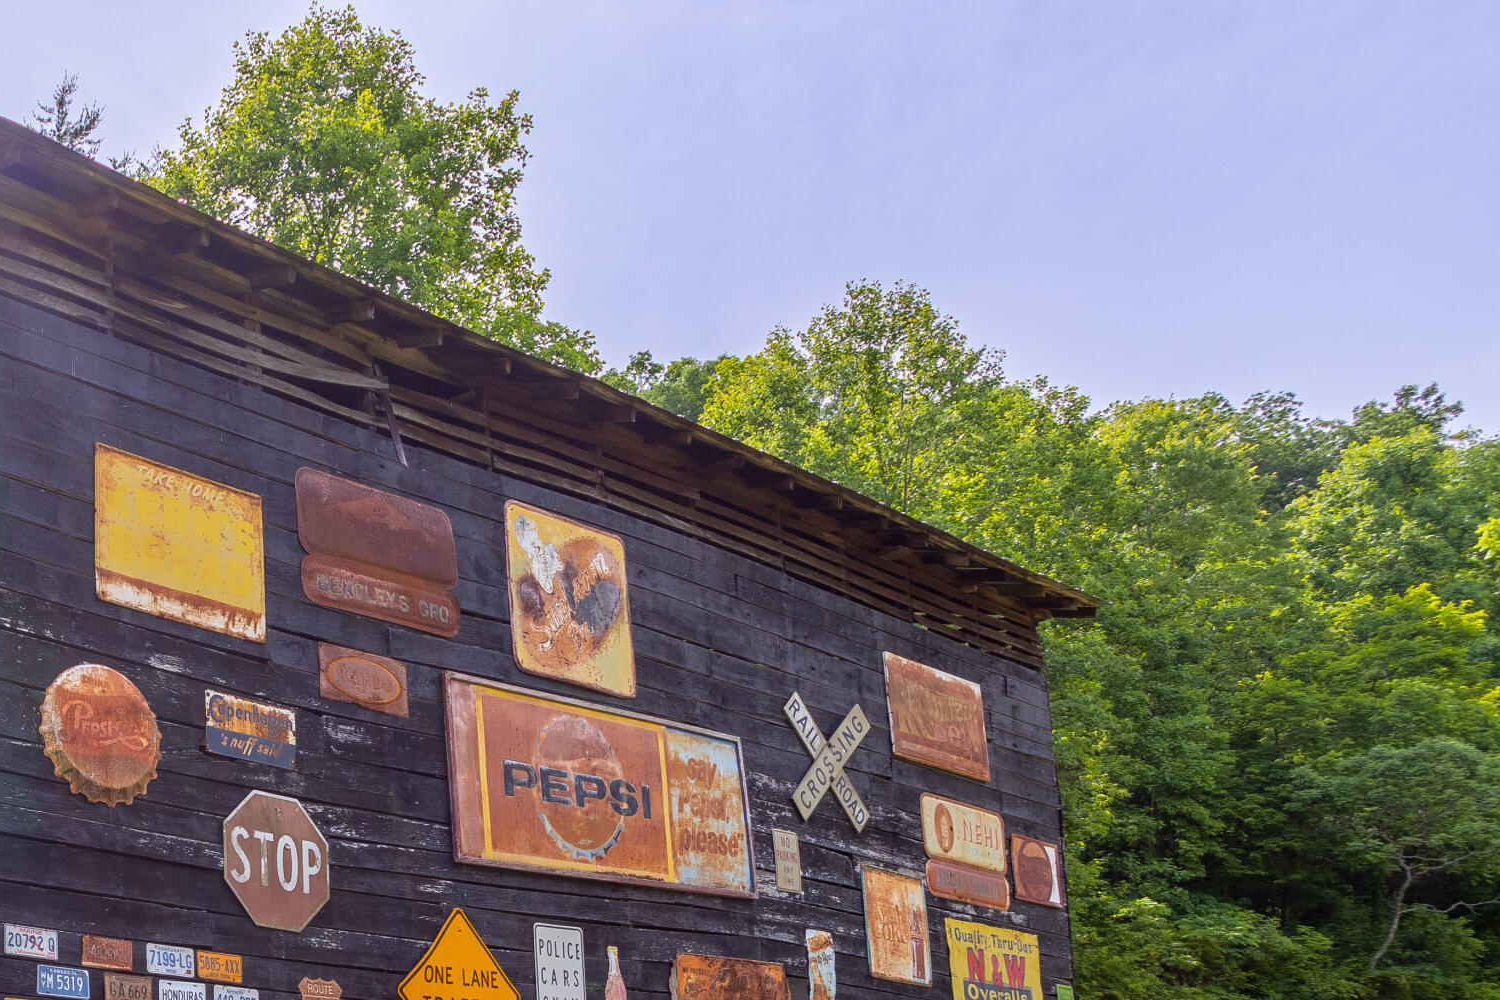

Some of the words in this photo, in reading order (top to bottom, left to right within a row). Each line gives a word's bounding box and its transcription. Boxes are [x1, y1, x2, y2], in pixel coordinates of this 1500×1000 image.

[209, 694, 294, 738] Copenhagen
[230, 737, 259, 757] nuff
[257, 743, 284, 758] said
[788, 699, 820, 752] RAIL
[835, 775, 866, 825] ROAD
[800, 715, 864, 810] CROSSING
[503, 759, 652, 820] PEPSI
[781, 836, 791, 849] NO
[962, 818, 1000, 850] NEHI
[229, 825, 322, 895] STOP
[776, 849, 799, 864] PARKING
[7, 931, 44, 952] 20792
[48, 937, 56, 952] Q
[538, 938, 581, 960] POLICE
[954, 927, 988, 951] Quality
[990, 934, 1033, 954] Thru-Out
[149, 949, 193, 970] 7199-LG
[199, 955, 241, 975] 5885-AXX
[56, 974, 84, 992] 5319
[423, 965, 454, 985] ONE
[461, 968, 499, 989] LANE
[541, 966, 580, 988] CARS
[110, 981, 126, 998] GA
[128, 983, 148, 999] 669
[307, 983, 334, 995] ROUTE
